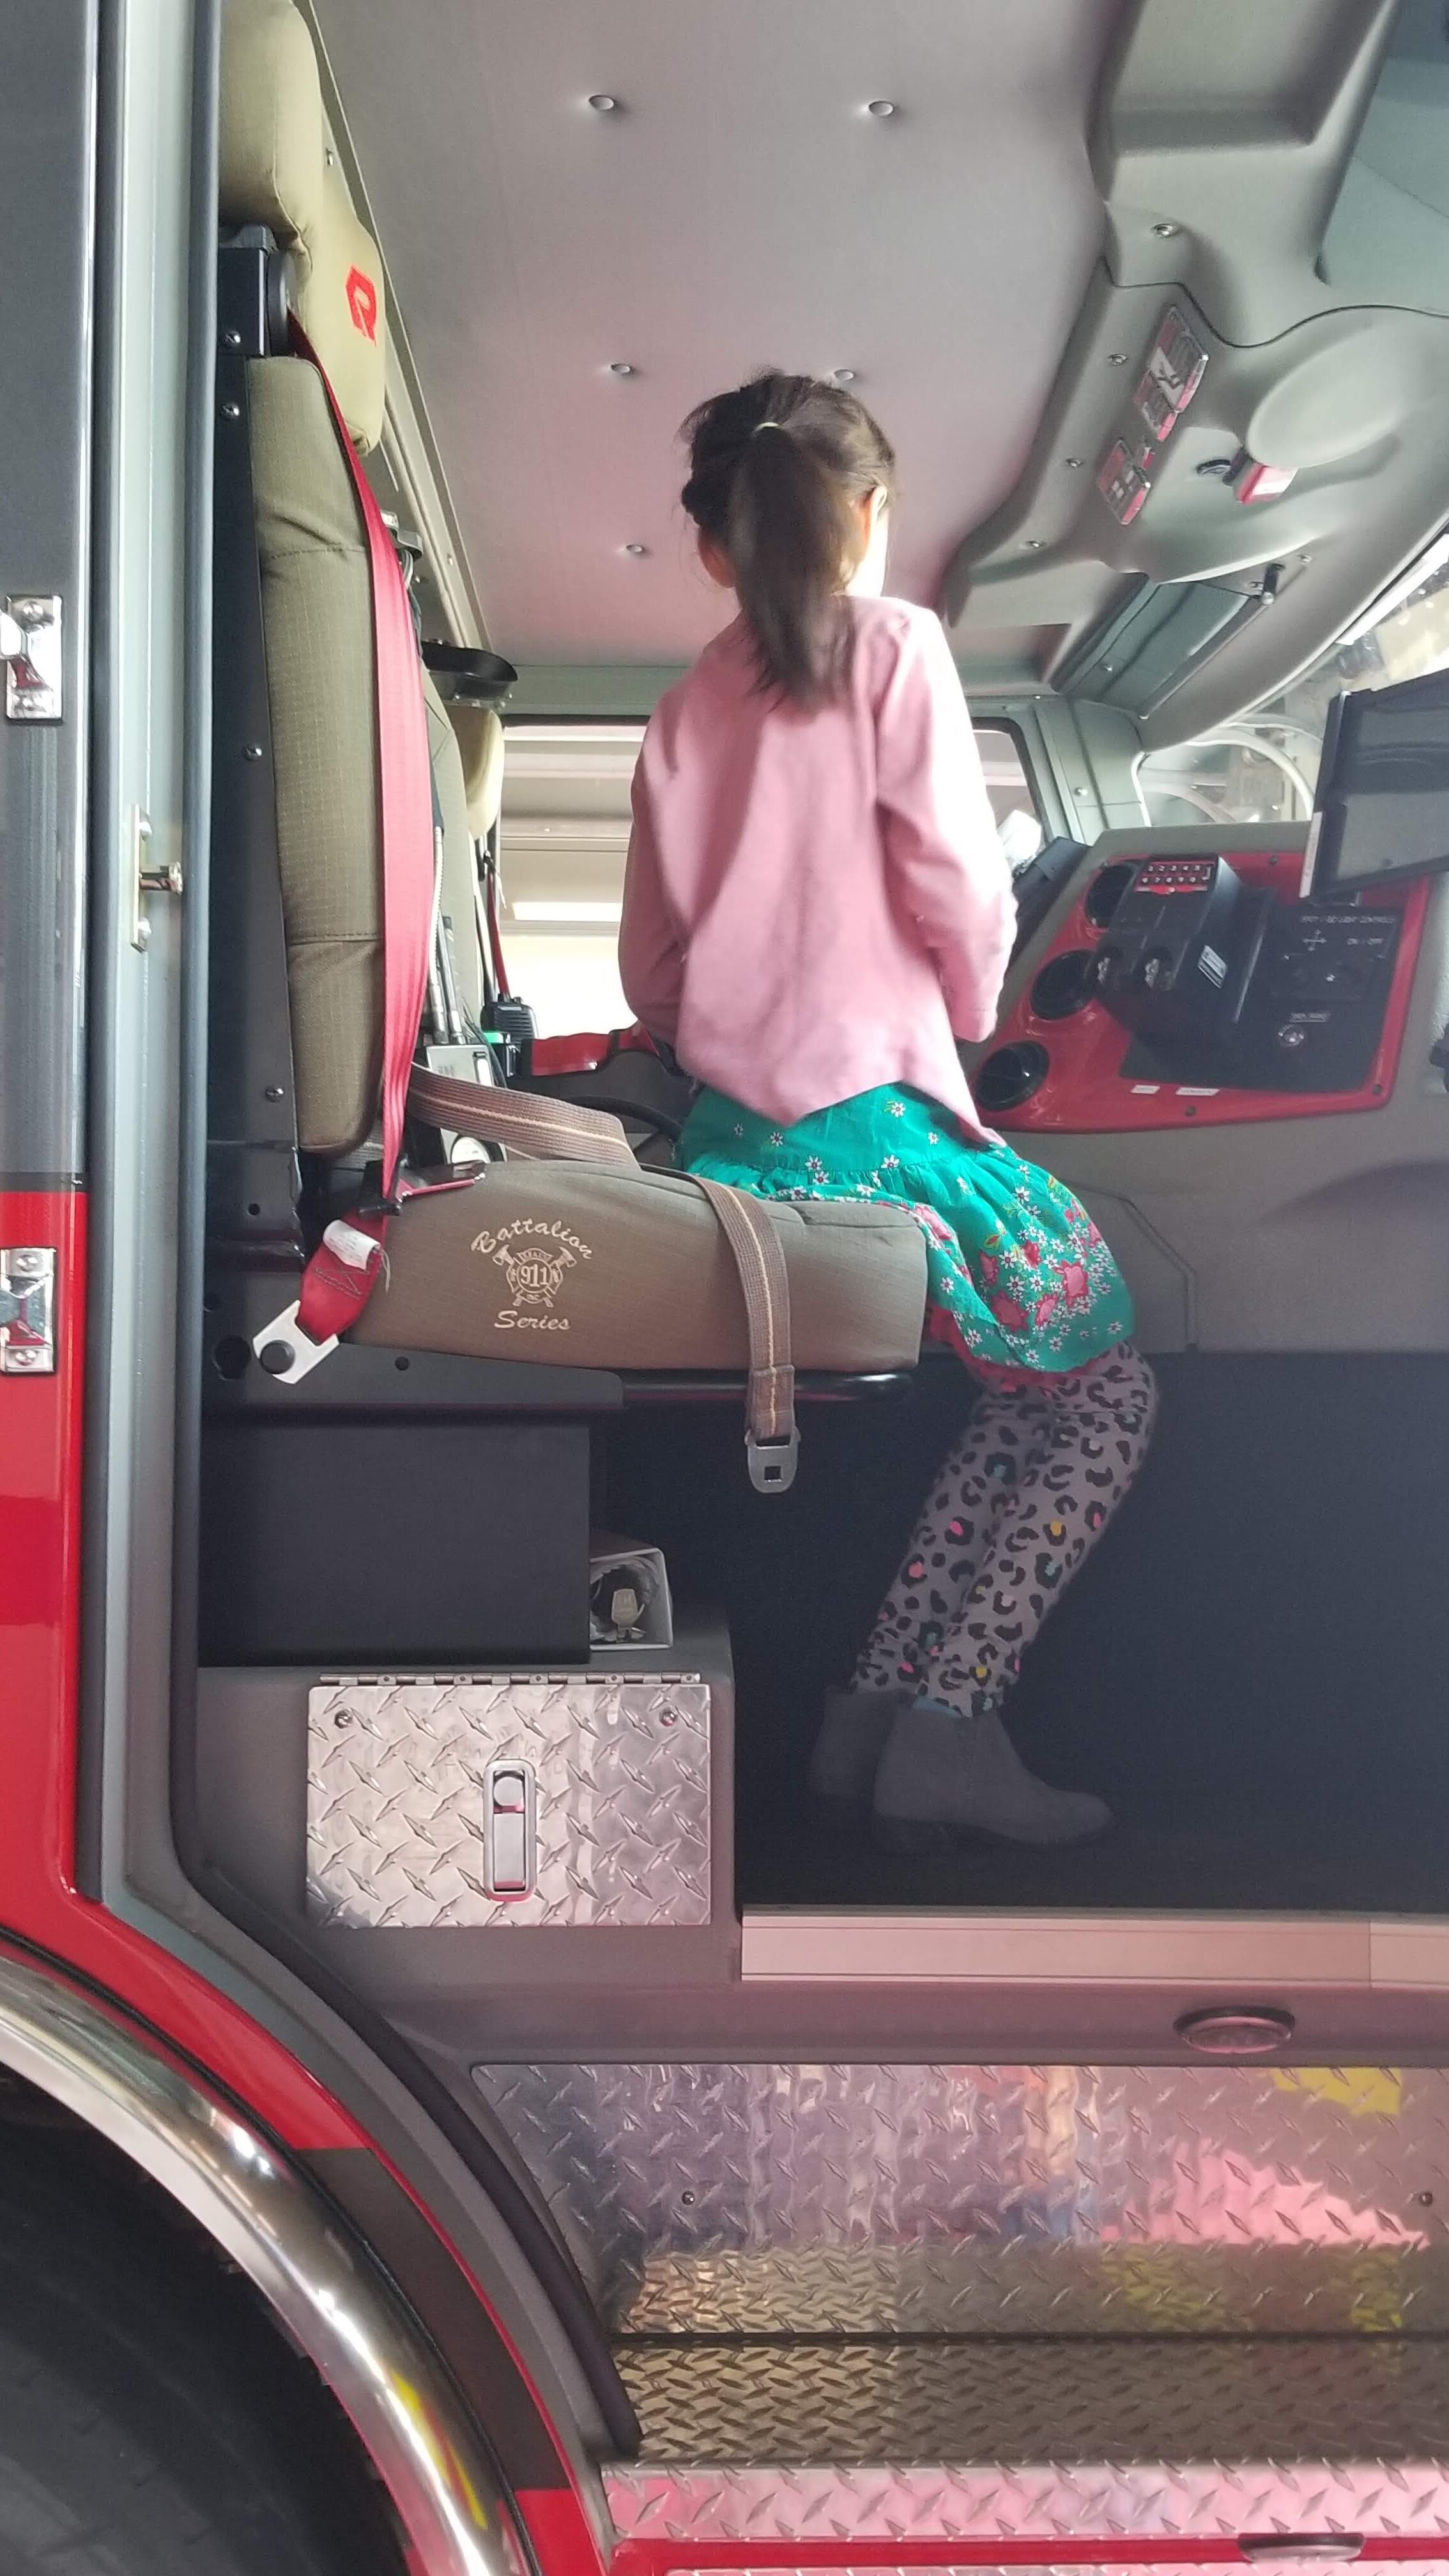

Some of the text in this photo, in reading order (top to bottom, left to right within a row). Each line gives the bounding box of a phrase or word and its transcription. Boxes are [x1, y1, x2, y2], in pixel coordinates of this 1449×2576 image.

[471, 1218, 592, 1259] Battalion
[520, 1264, 549, 1287] 911
[493, 1310, 571, 1330] Series
